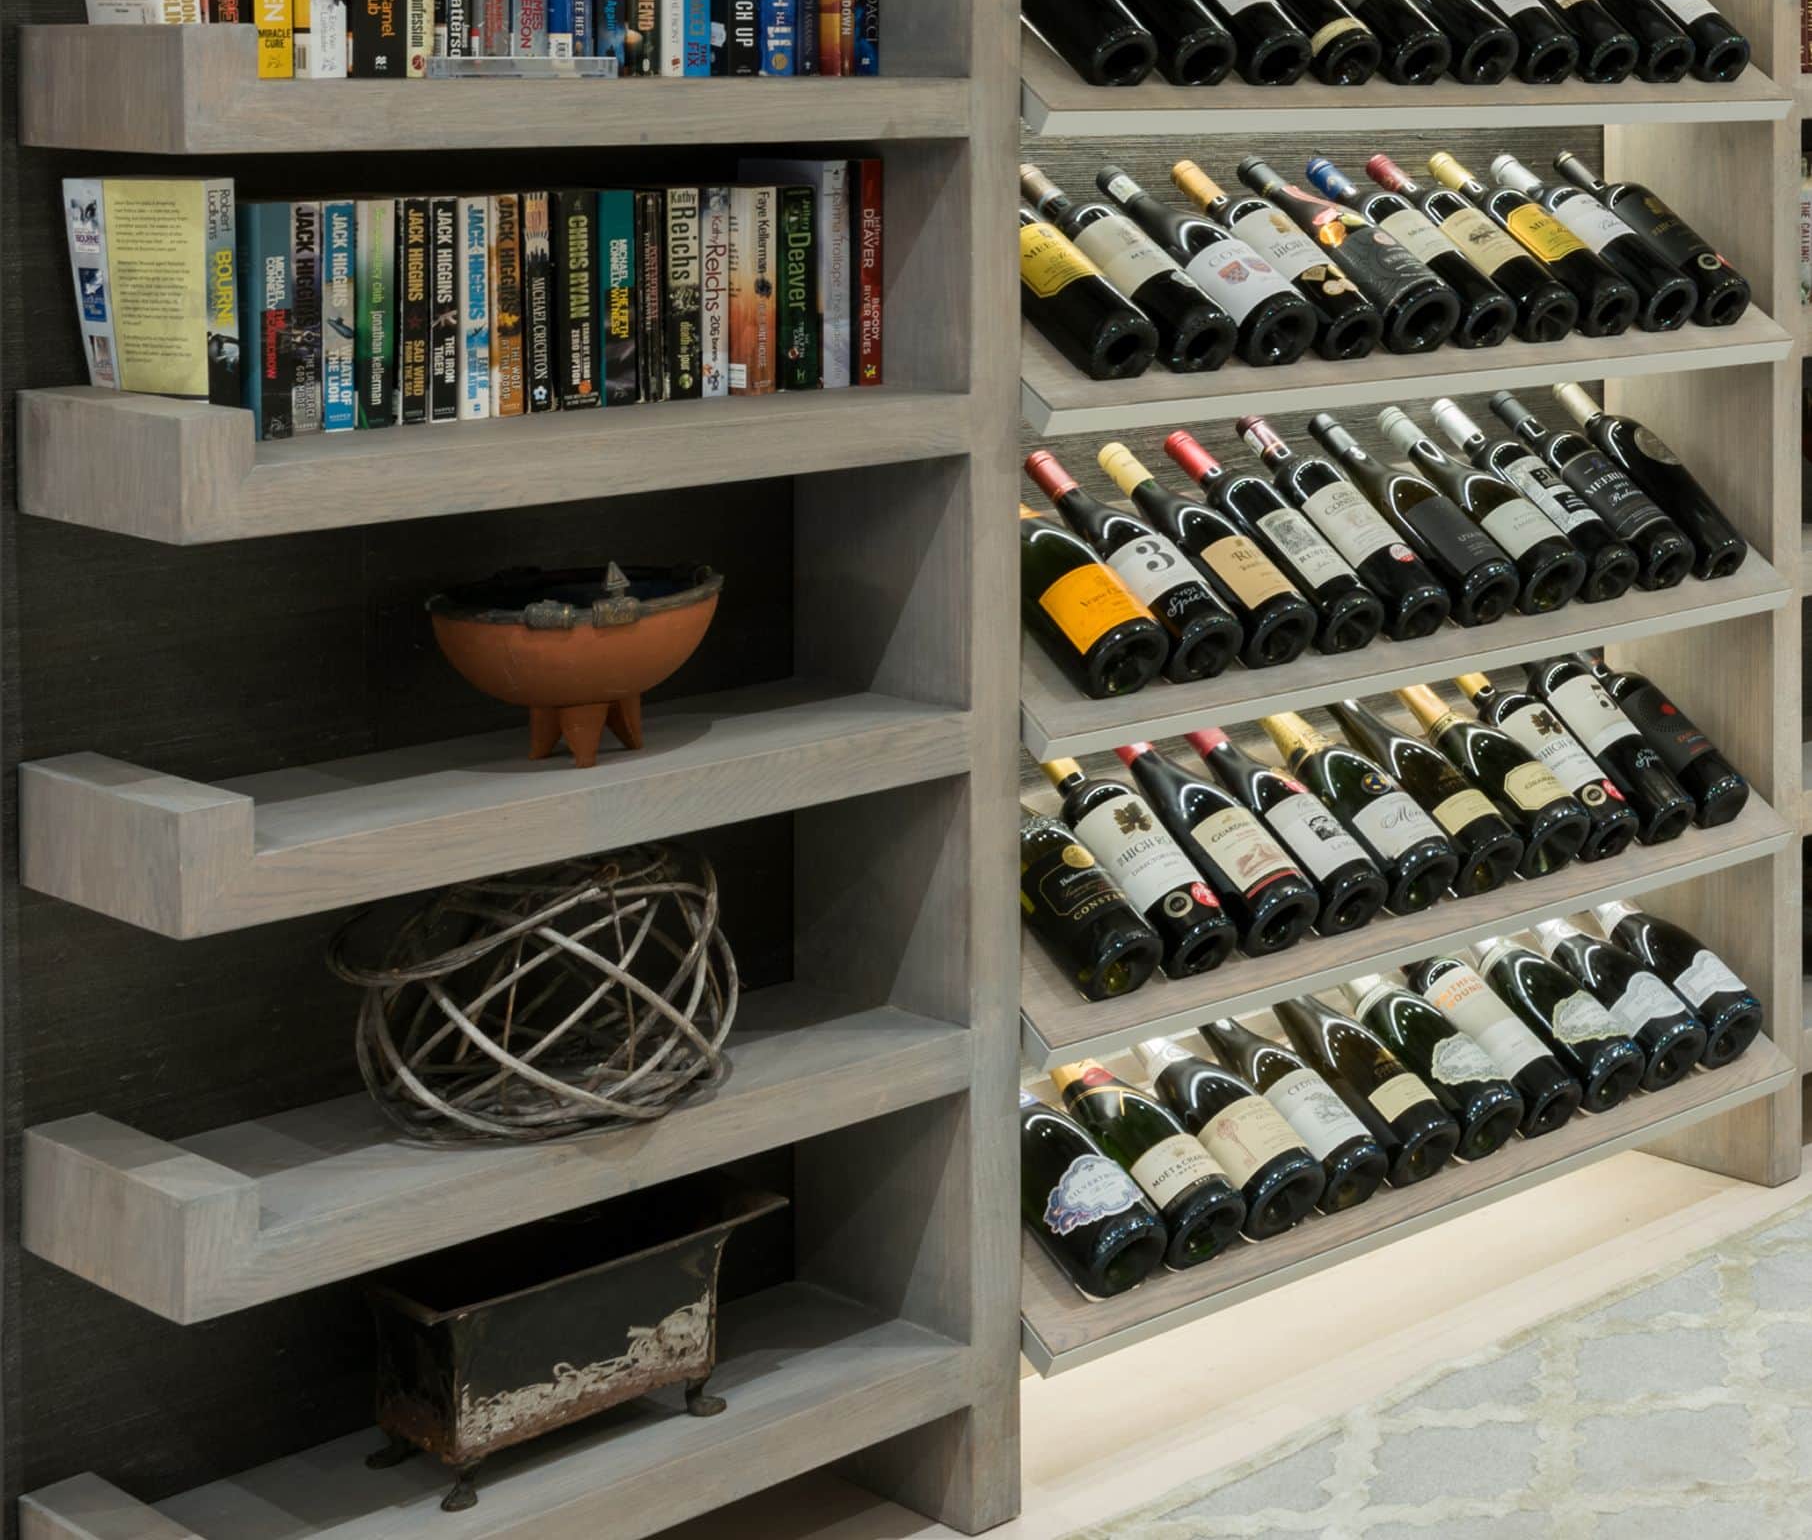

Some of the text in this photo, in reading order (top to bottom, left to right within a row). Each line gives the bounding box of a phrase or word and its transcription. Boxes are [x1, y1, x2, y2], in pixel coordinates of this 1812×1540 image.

[575, 16, 585, 37] HER
[687, 42, 700, 67] FIX
[735, 27, 754, 47] UP
[219, 189, 232, 232] Robert
[296, 207, 314, 253] JACK
[756, 191, 771, 274] Faye Kellerman
[863, 208, 874, 268] DEAVER
[333, 213, 348, 307] JACK HIGGINS
[408, 209, 425, 301] JACK HIGGINS
[437, 208, 454, 304] JACK HIGGINS
[468, 204, 486, 320] JACK HIGGINS
[499, 199, 517, 312] JACK HIGGINS
[568, 215, 590, 319] CHRIS RYAN
[670, 206, 697, 281] Reichs
[788, 231, 812, 312] Deaver
[214, 250, 235, 327] BOURNE
[619, 287, 629, 306] THE
[705, 244, 727, 336] Reichs 206
[871, 297, 880, 340] BLOODY
[532, 277, 549, 379] MICHAEL CRICHTON
[863, 285, 872, 354] RIVER BLUES
[328, 351, 340, 403] THE LION
[340, 345, 352, 406] WRATH OF
[370, 310, 386, 405] jonathan kellerman
[412, 339, 425, 396] SAD WIND
[434, 346, 445, 374] TIGER
[445, 336, 456, 383] THE IRON
[570, 329, 581, 385] ZERO OPTION
[1136, 540, 1175, 572] 3
